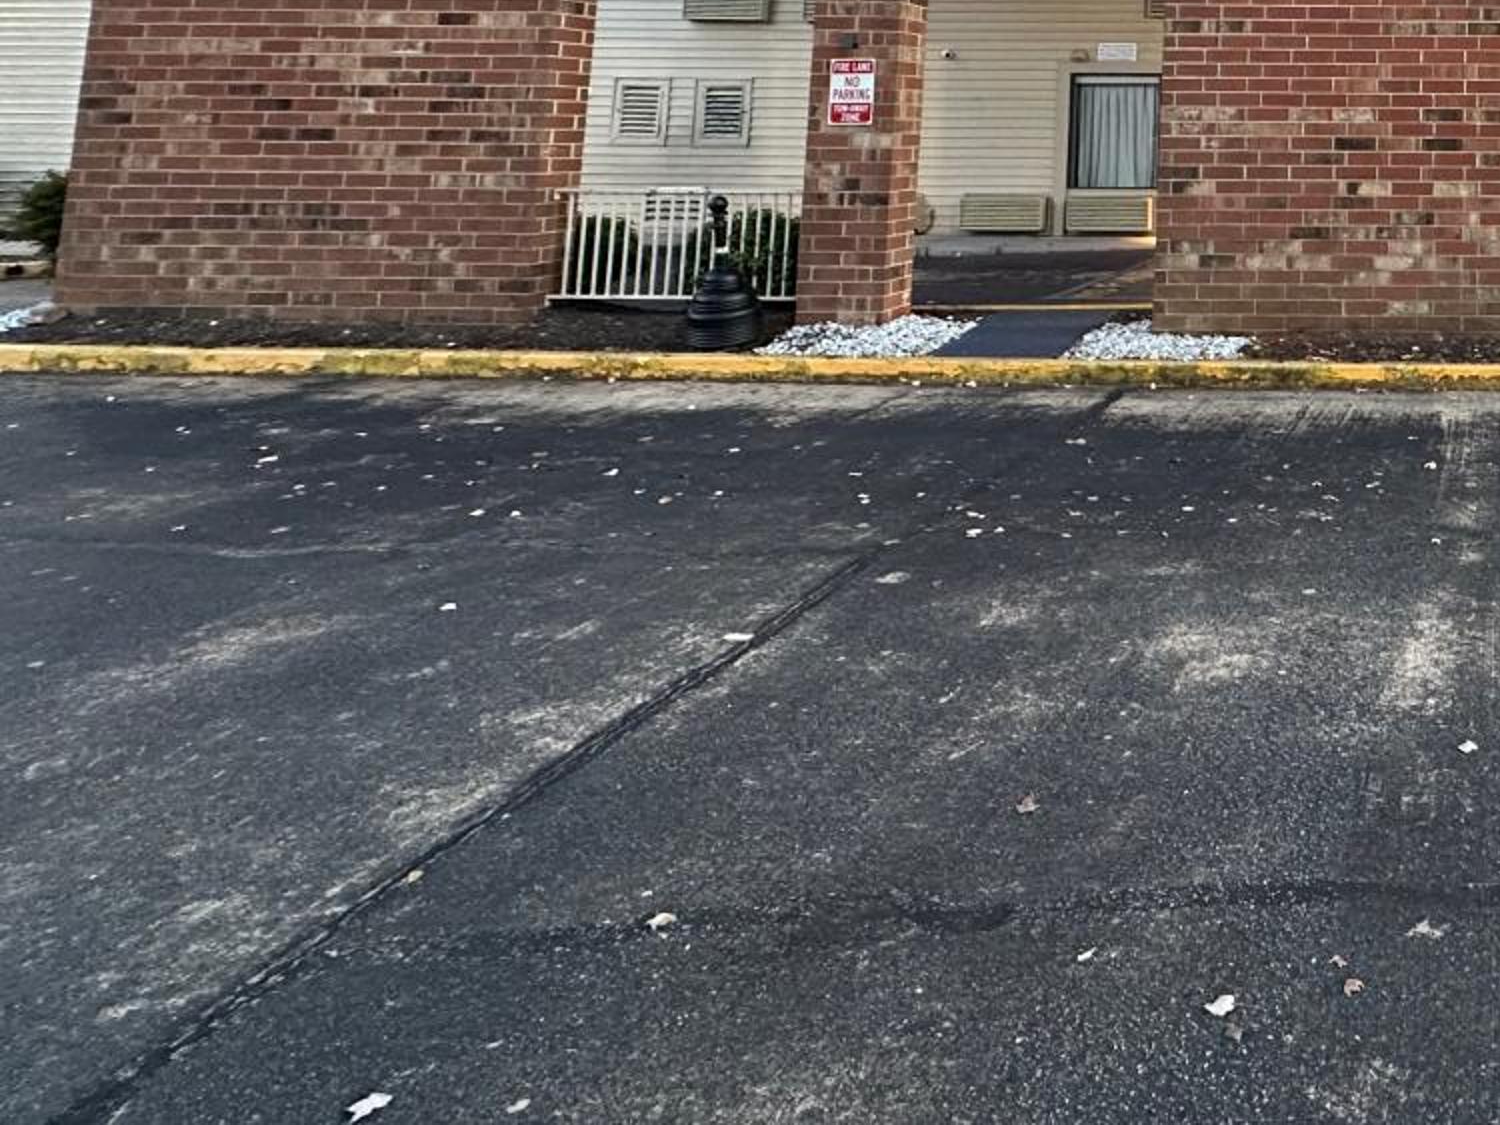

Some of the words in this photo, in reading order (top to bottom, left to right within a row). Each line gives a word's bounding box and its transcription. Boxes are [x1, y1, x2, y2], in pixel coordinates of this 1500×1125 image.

[852, 62, 871, 72] LANE
[844, 76, 861, 87] NO
[832, 88, 871, 100] PARKING
[841, 112, 861, 122] ZONE
